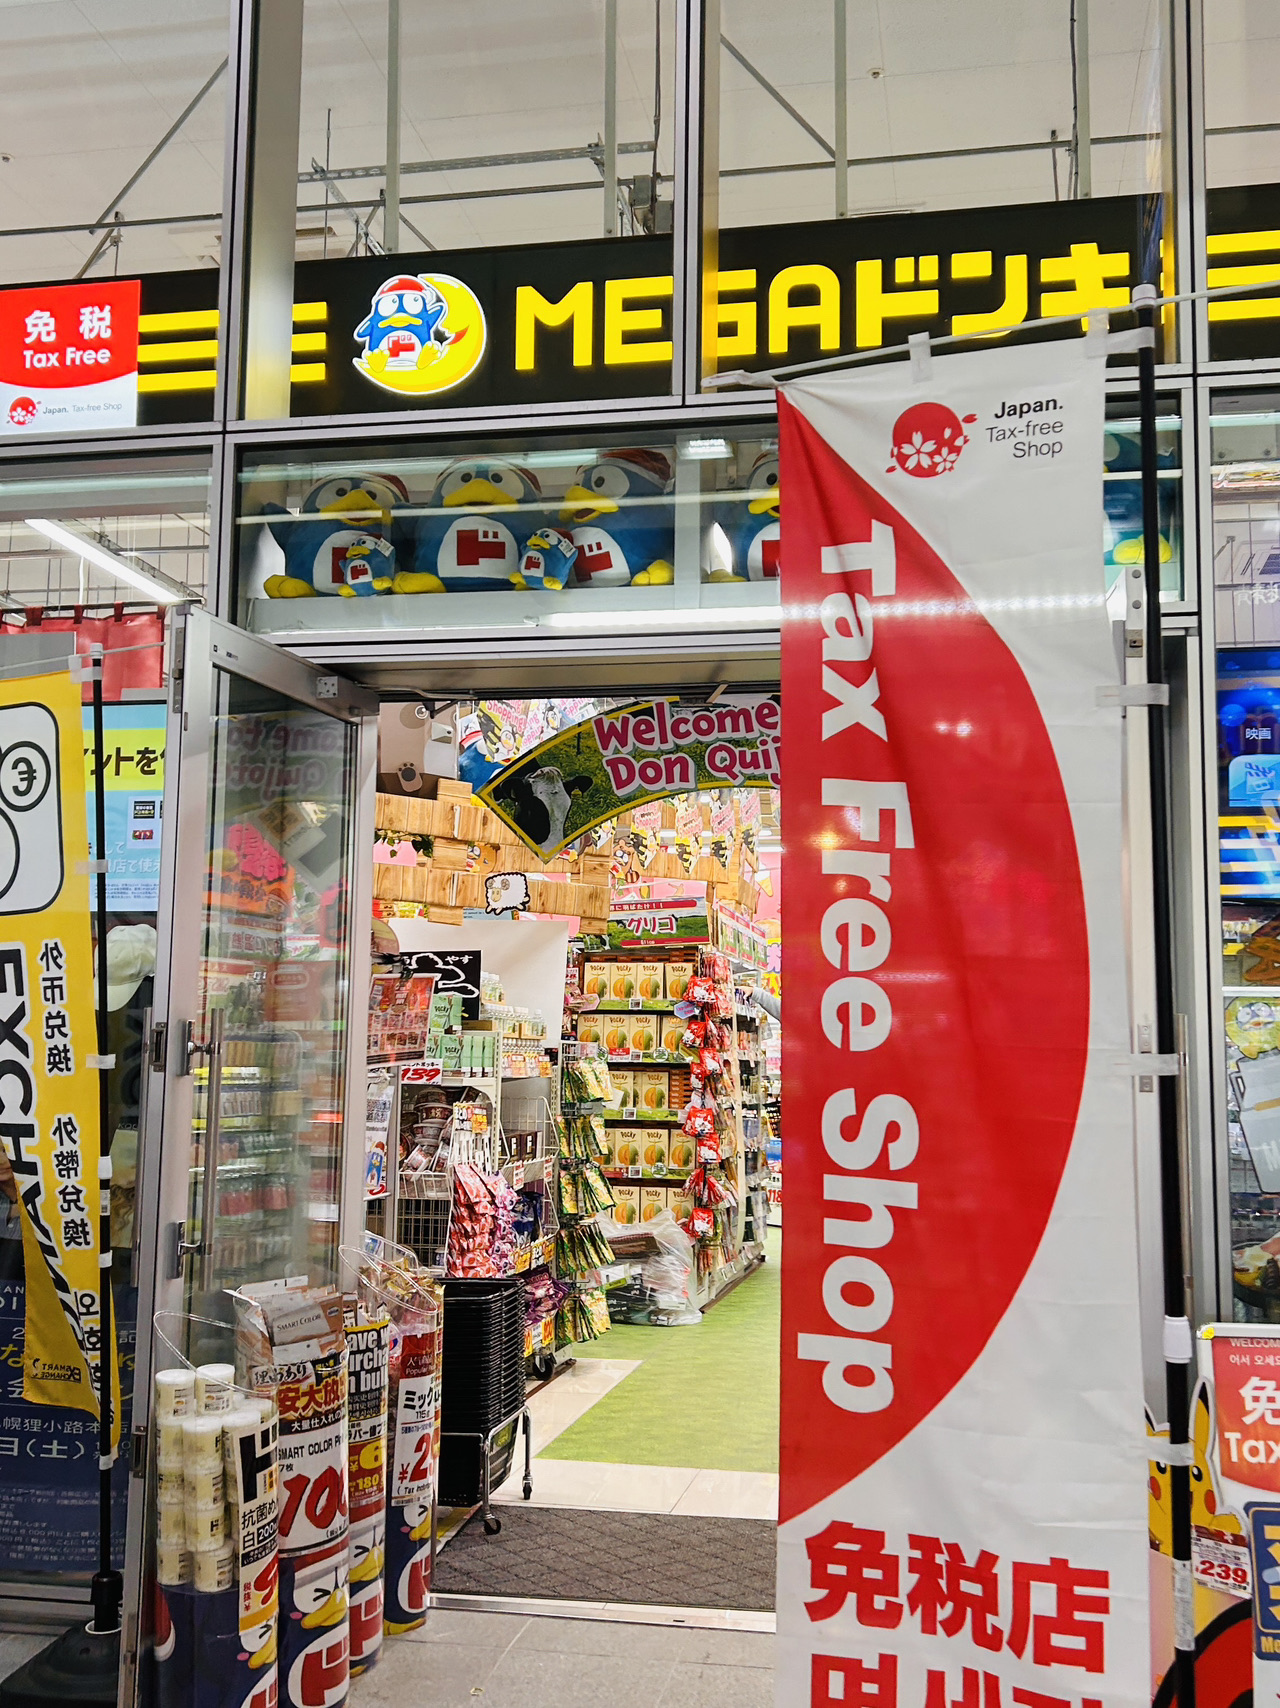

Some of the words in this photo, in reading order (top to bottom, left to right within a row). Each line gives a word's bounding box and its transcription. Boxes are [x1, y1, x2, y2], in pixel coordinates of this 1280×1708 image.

[24, 305, 111, 343] 免税
[23, 349, 60, 368] Tax
[65, 346, 111, 367] Free
[43, 406, 69, 415] Japan.
[72, 403, 101, 412] Tax-free
[103, 401, 122, 412] Shop
[994, 398, 1063, 419] Japan.
[985, 418, 1063, 443] Tax-free
[1012, 438, 1063, 459] Shop
[820, 519, 896, 742] Tax
[593, 702, 779, 752] Welcome
[1245, 727, 1271, 739] 映画
[605, 755, 690, 790] Don
[820, 777, 915, 1053] Free
[626, 916, 676, 936] グリコ
[401, 1067, 441, 1081] 139
[798, 1087, 920, 1414] Shop
[347, 1330, 378, 1352] ave
[1230, 1338, 1280, 1348] WELCOM
[1229, 1354, 1250, 1366] 어서
[0, 1416, 128, 1434] 幌狸小路本
[308, 1438, 332, 1456] COLOR
[804, 1520, 1110, 1674] 免税店
